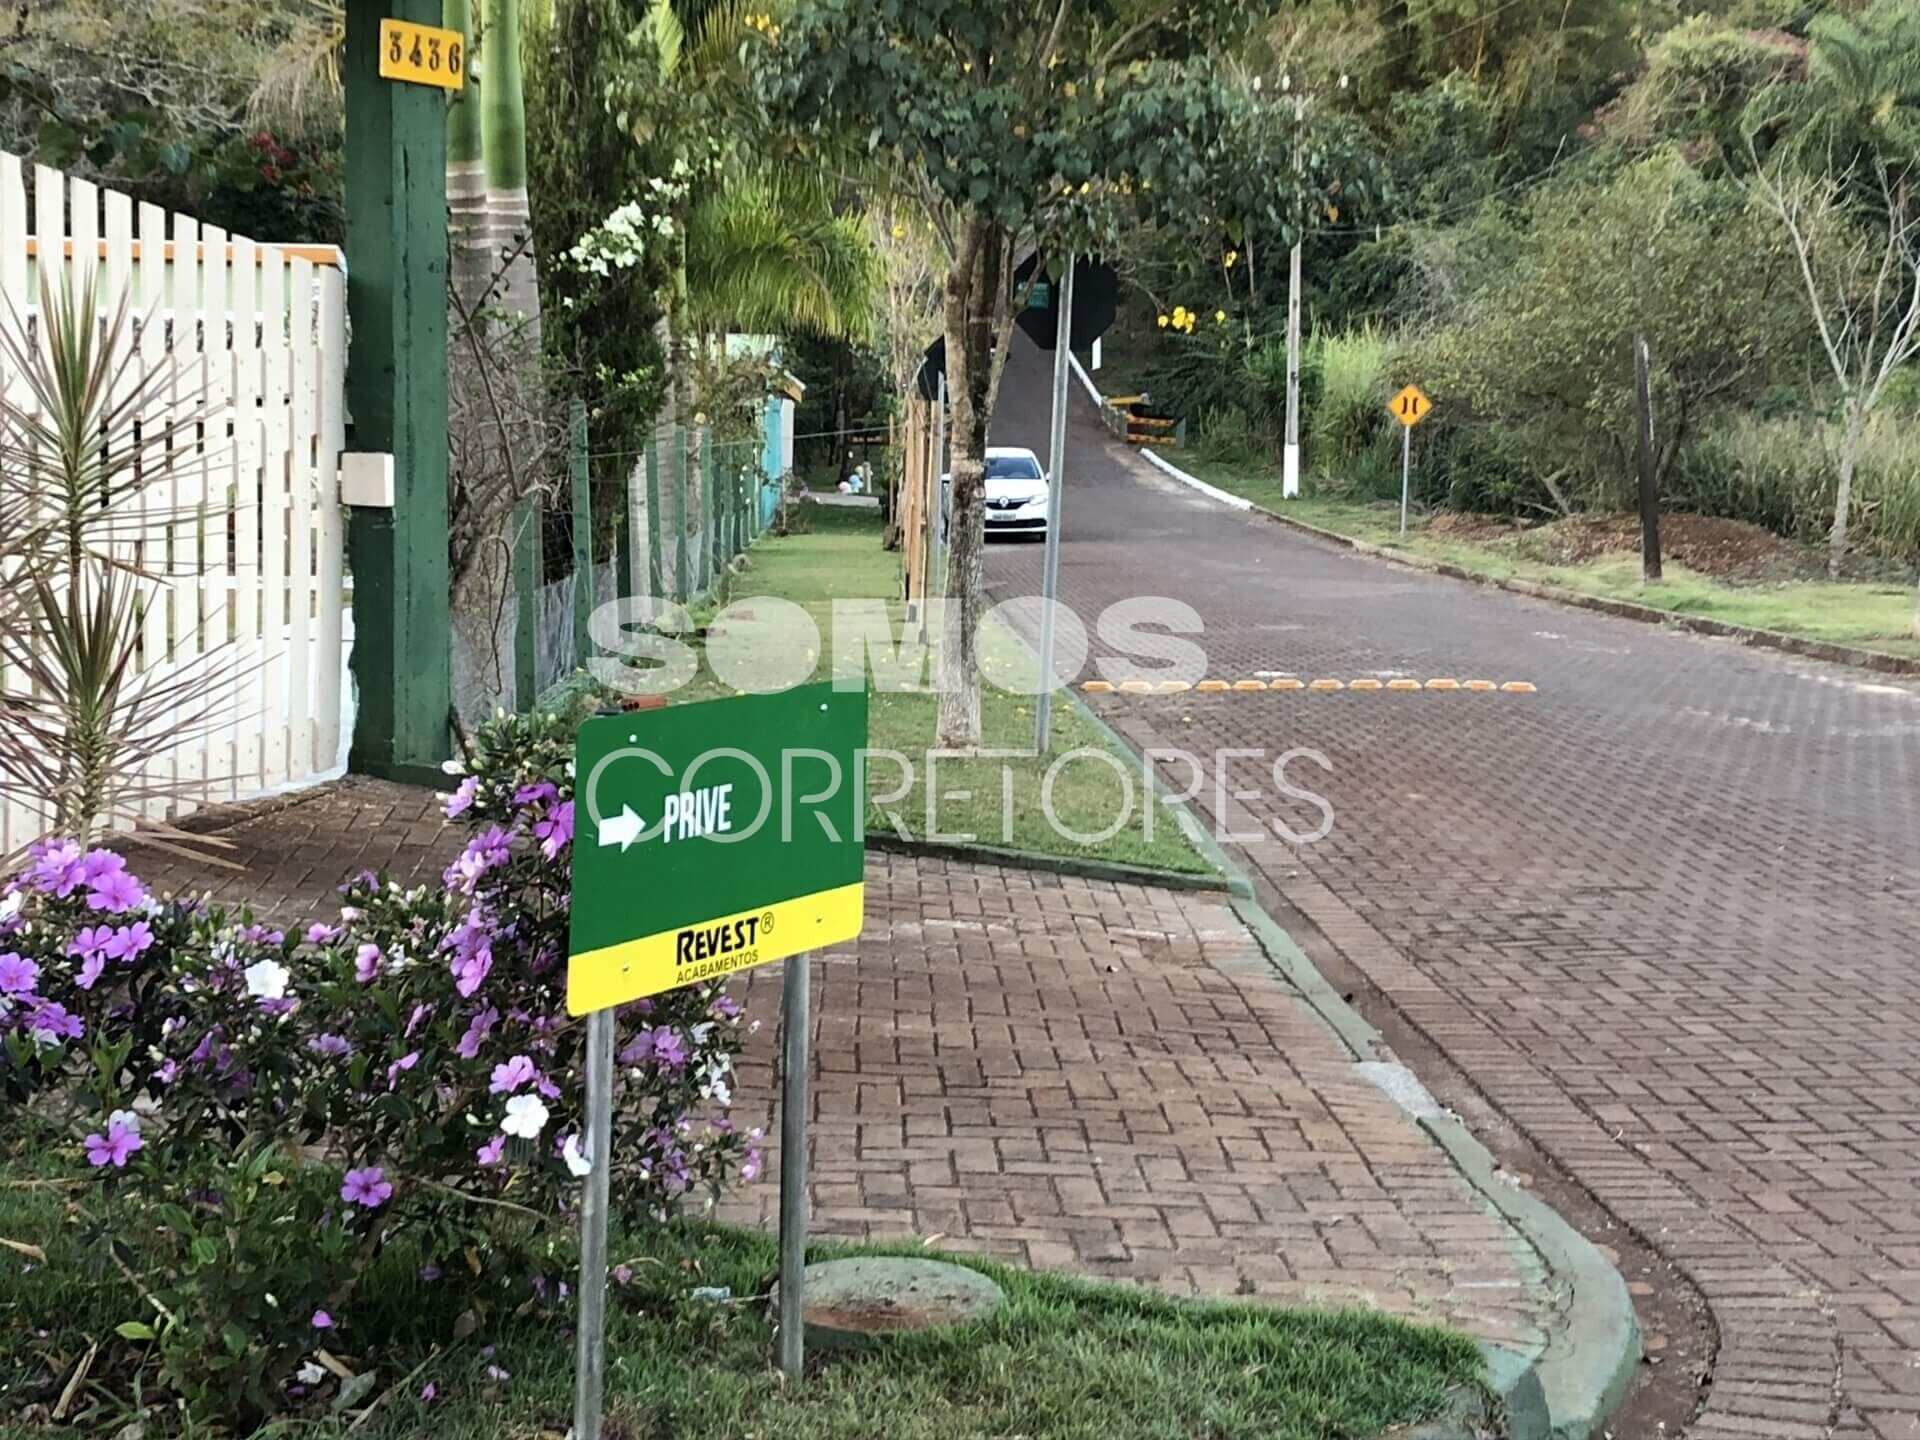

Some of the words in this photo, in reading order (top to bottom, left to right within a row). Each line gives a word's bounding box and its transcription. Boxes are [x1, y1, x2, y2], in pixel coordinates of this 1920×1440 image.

[390, 31, 460, 74] 3436
[664, 783, 732, 844] PRIVE
[677, 949, 759, 984] ACABAMENTOS
